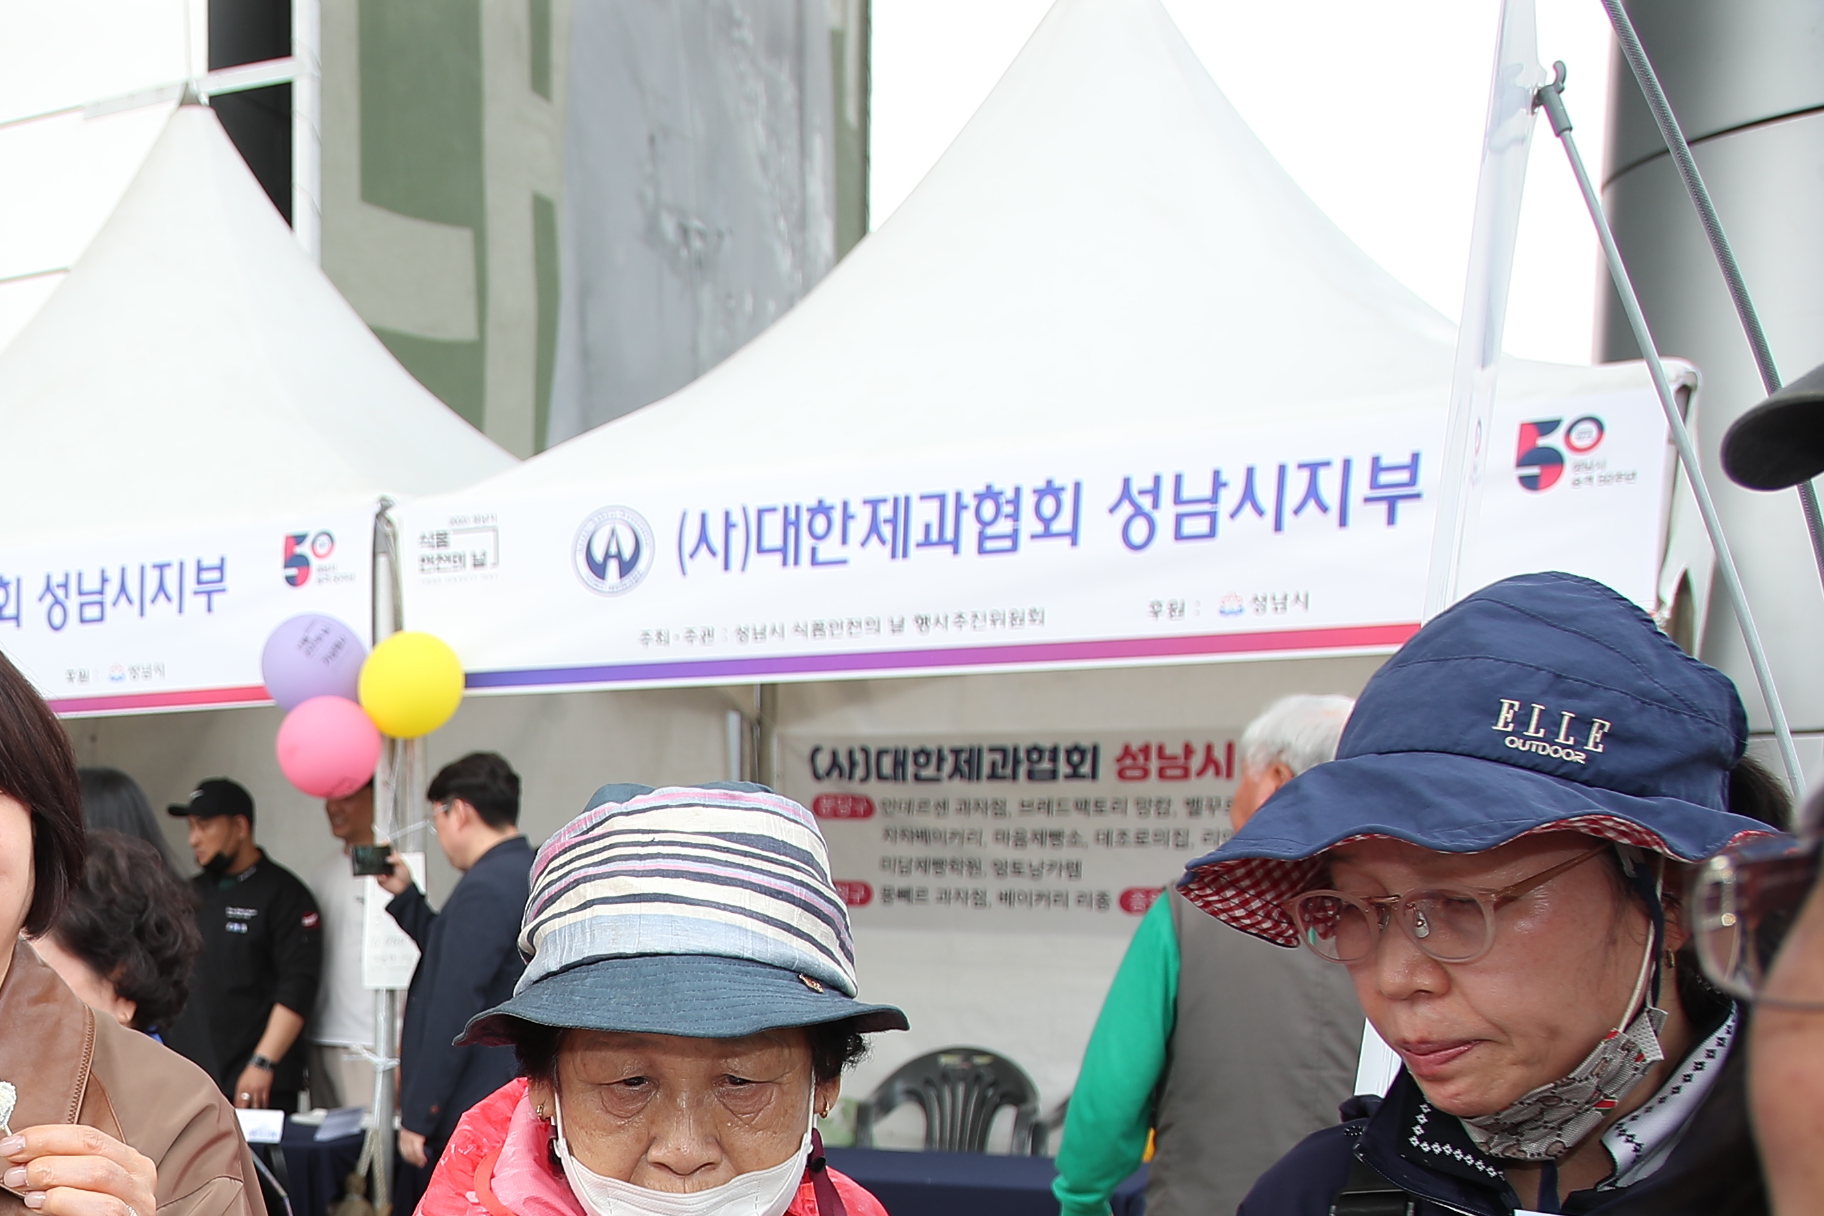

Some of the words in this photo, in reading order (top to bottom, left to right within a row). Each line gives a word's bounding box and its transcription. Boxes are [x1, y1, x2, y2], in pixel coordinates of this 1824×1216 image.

[677, 477, 1083, 577] (사)대한제과협회
[1108, 451, 1423, 551] 성남시지부
[37, 554, 229, 631] 성남시지부
[1252, 590, 1309, 615] 성남시
[735, 620, 785, 644] 성남시
[793, 614, 881, 638] 식품안전의
[889, 613, 905, 635] 날
[914, 606, 1045, 633] 행사추진위원회
[1491, 698, 1612, 753] ELLE
[809, 742, 1101, 782] (사)대한제과협회
[1504, 735, 1588, 764] OUTDOOR
